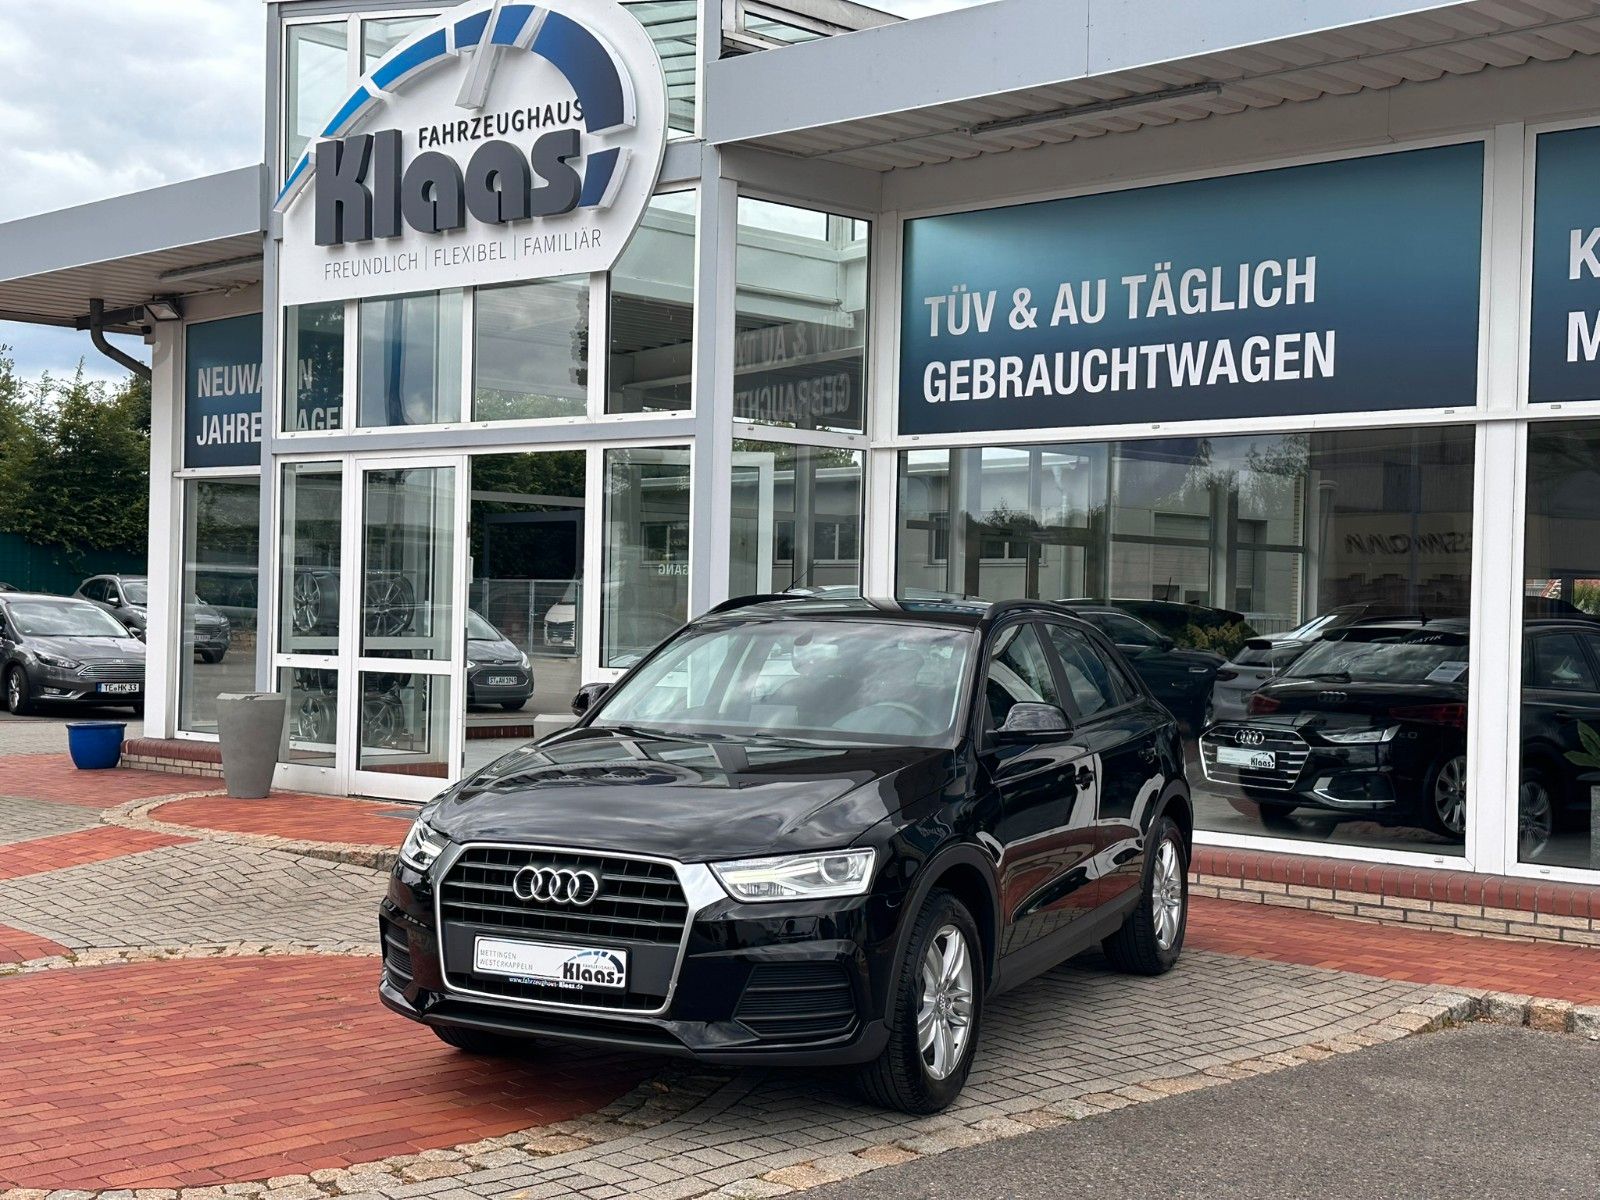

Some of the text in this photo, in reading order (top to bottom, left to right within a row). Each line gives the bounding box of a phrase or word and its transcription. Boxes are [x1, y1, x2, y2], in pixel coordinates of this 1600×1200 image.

[419, 98, 584, 148] FAHRZEUGHAUS
[315, 128, 582, 246] Klaas
[325, 227, 602, 280] FREUNDLICH FLEXIBEL FAMILIÄR
[924, 255, 1317, 337] TÜV & AU TÄGLICH
[923, 330, 1336, 404] GEBRAUCHTWAGEN
[563, 961, 615, 984] Klaas
